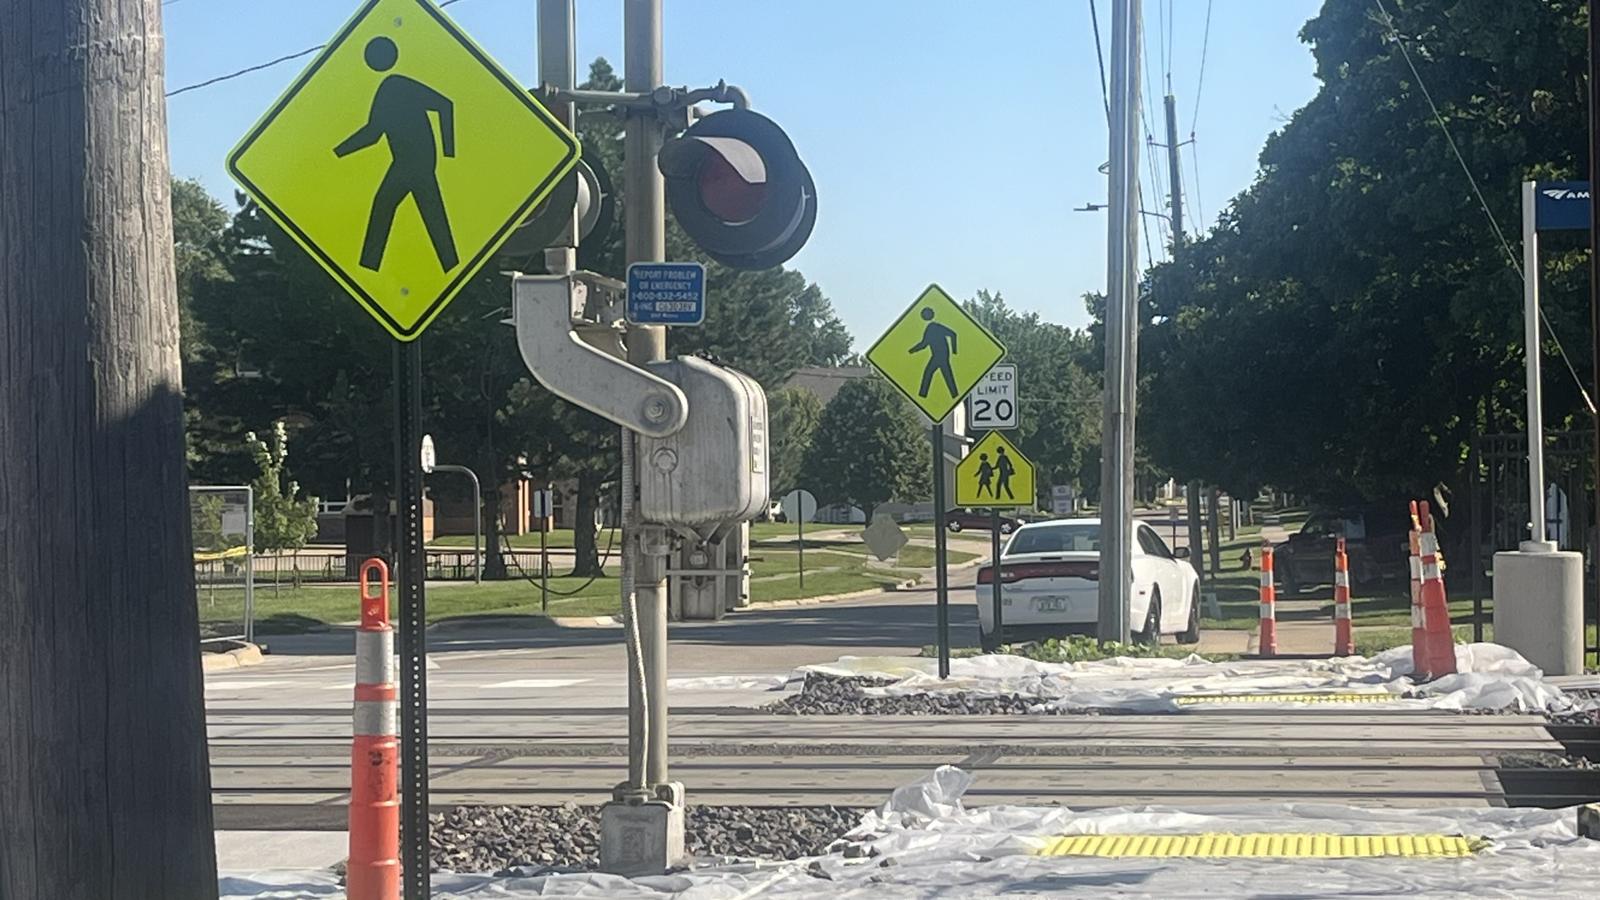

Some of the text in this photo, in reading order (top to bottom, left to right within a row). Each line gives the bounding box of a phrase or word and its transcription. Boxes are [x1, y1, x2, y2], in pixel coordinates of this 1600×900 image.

[1566, 191, 1590, 199] AM
[664, 270, 697, 279] PROBLEM
[639, 281, 692, 290] OR EMERGENCY
[985, 372, 1013, 381] EED
[977, 385, 1008, 395] LIMIT
[974, 399, 1013, 421] 20
